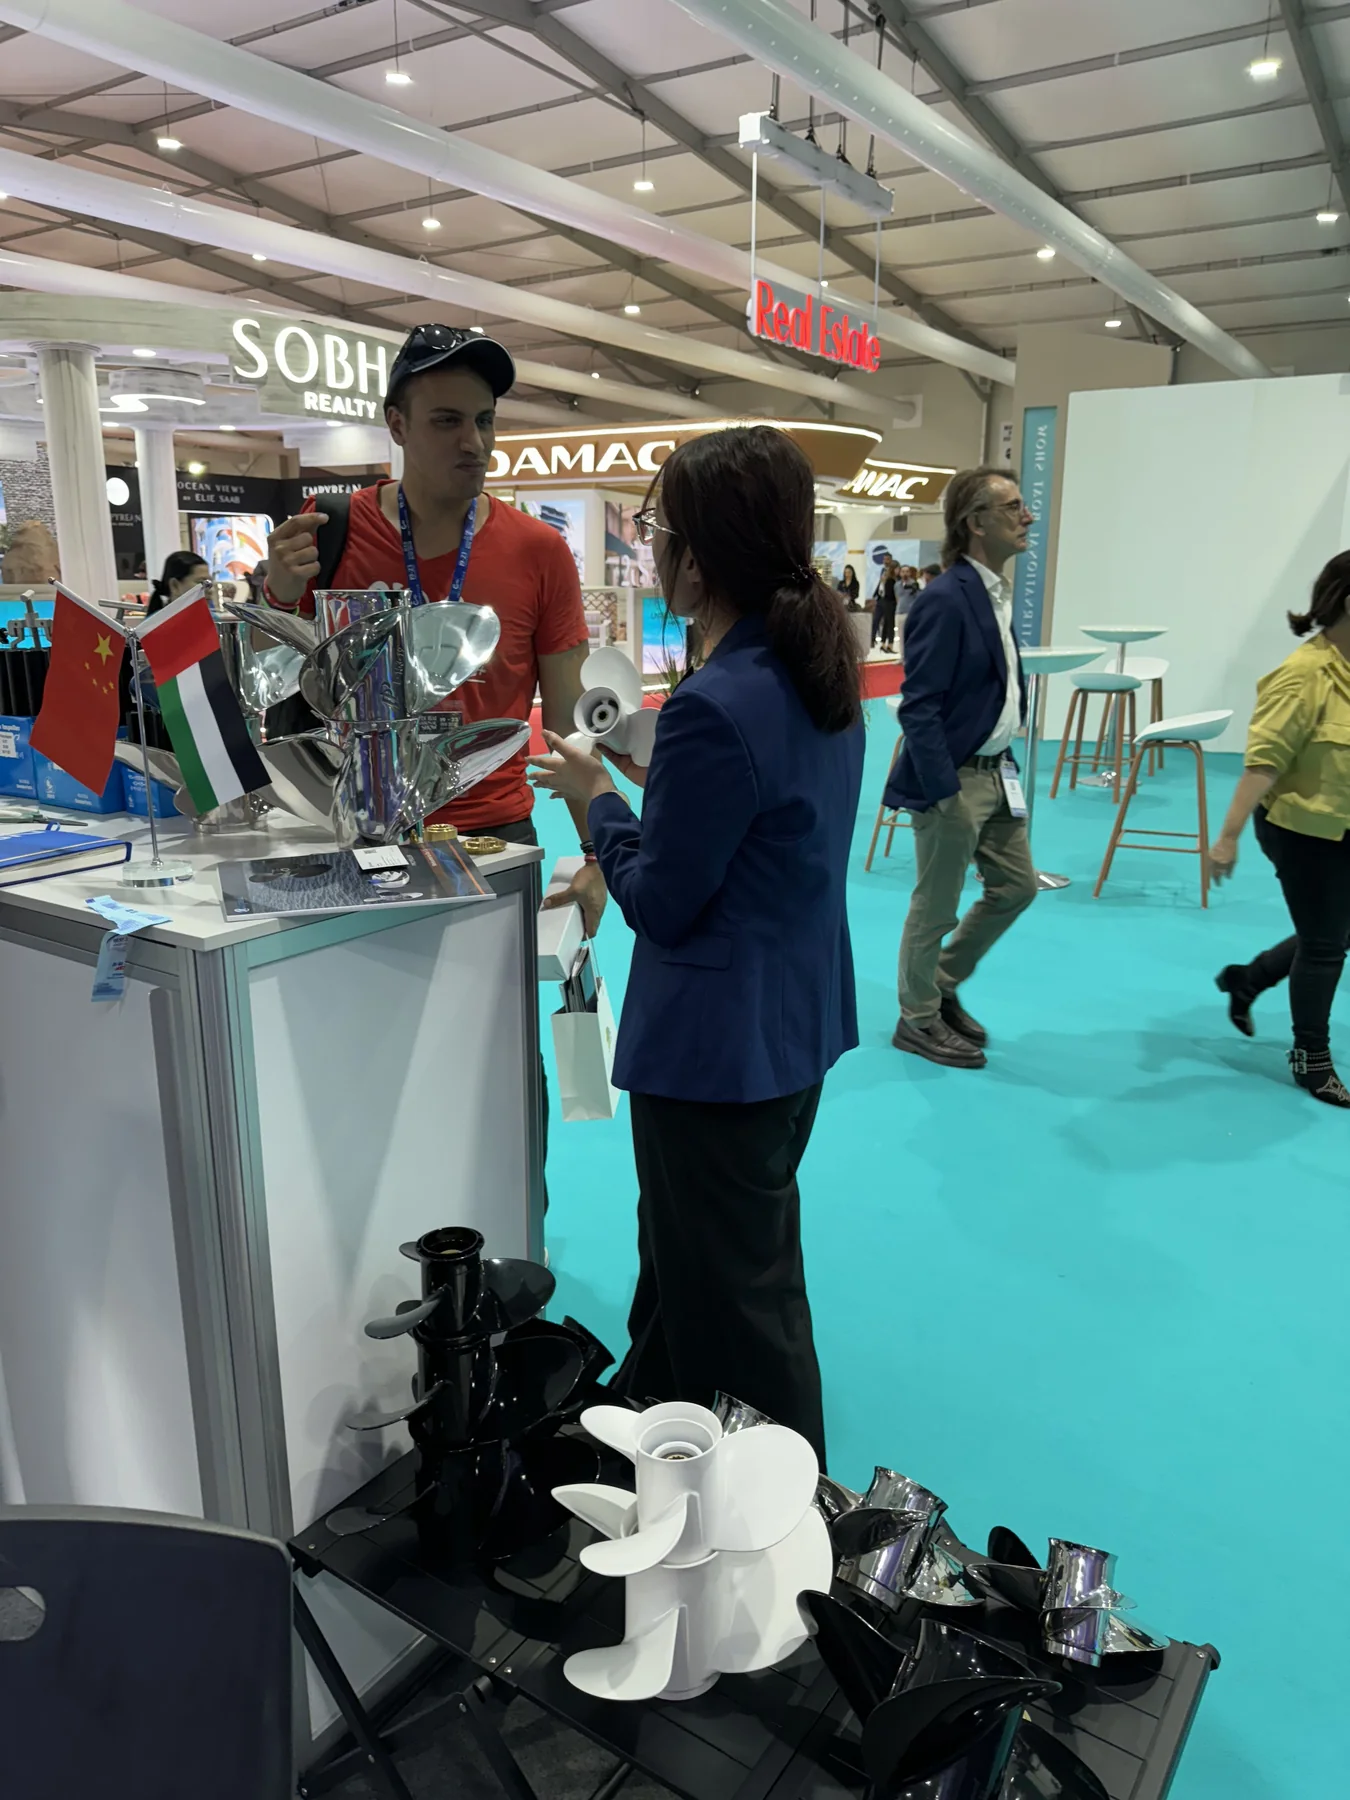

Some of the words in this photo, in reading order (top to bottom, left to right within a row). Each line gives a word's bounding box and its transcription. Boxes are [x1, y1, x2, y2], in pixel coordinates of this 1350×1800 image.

[756, 280, 812, 347] Real
[819, 305, 880, 372] Estate
[232, 318, 399, 398] SOBH
[304, 391, 377, 419] REALTY
[177, 482, 211, 491] OCEAN
[215, 484, 245, 494] VIEWS
[195, 493, 215, 503] ELIE
